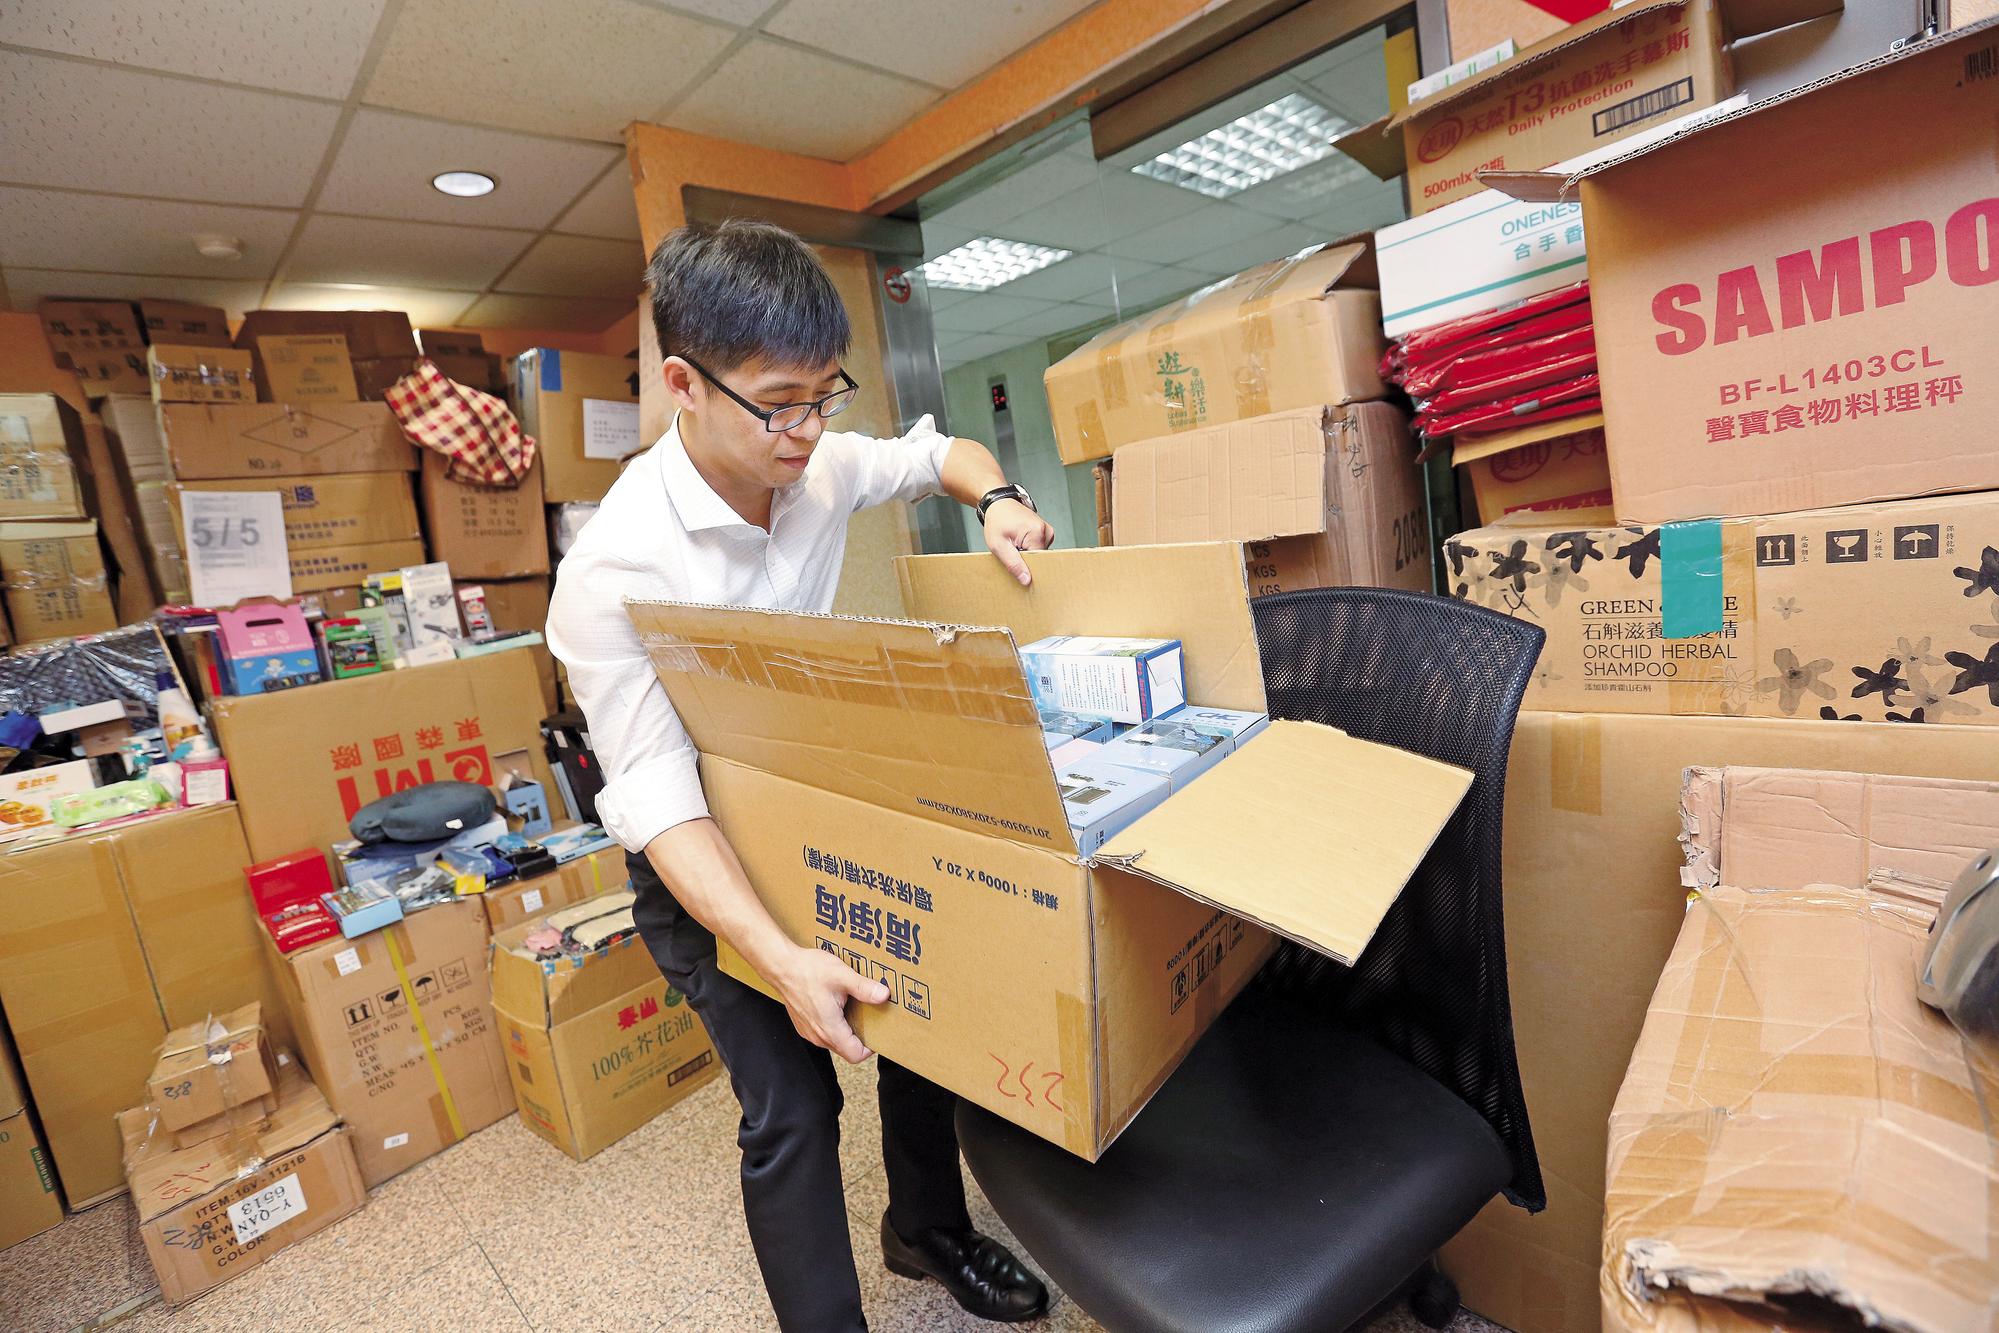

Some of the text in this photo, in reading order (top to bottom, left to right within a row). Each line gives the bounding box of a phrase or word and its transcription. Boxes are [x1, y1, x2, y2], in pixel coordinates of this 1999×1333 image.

[1508, 114, 1545, 137] Daily
[1550, 78, 1634, 120] Protection
[1652, 198, 1999, 356] SAMPO
[1719, 345, 1944, 406] BF-L1403CL
[1705, 374, 1965, 443] 聲寶食物料理秤
[1253, 564, 1277, 578] KGS
[1258, 584, 1281, 597] KGS
[1581, 600, 1654, 615] GREEN
[1582, 620, 1738, 640] 石斛滋養精
[1583, 643, 1738, 659] ORCHID HERBAL
[1584, 662, 1677, 677] SHAMPOO
[330, 716, 484, 771] 東森國際
[916, 797, 1053, 840] 20150309-520X380X262mm
[803, 845, 934, 912] 環保洗衣精(檸檬)
[947, 863, 962, 877] 20
[815, 884, 922, 965] 清淨海
[352, 1030, 380, 1049] ITEM
[241, 1185, 286, 1215] 6513
